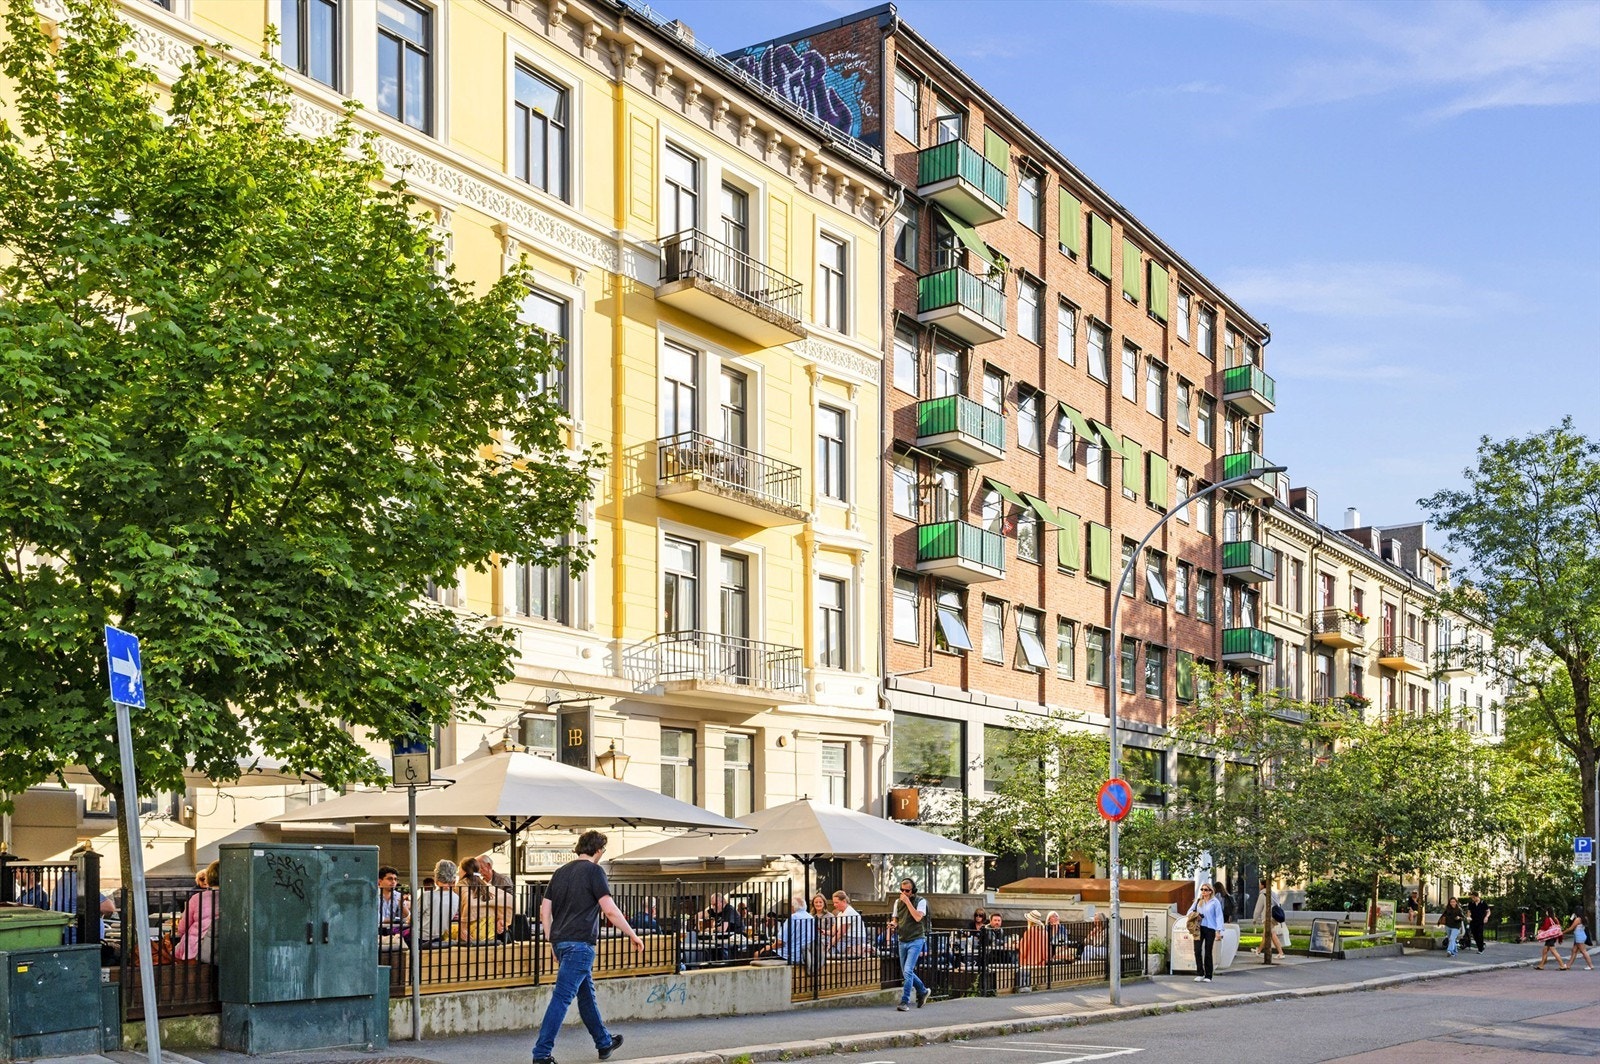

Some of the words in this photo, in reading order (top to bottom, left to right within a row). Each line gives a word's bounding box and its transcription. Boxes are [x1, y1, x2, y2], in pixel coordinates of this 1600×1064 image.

[568, 728, 583, 747] HB
[1578, 839, 1588, 851] P
[529, 852, 546, 863] THE
